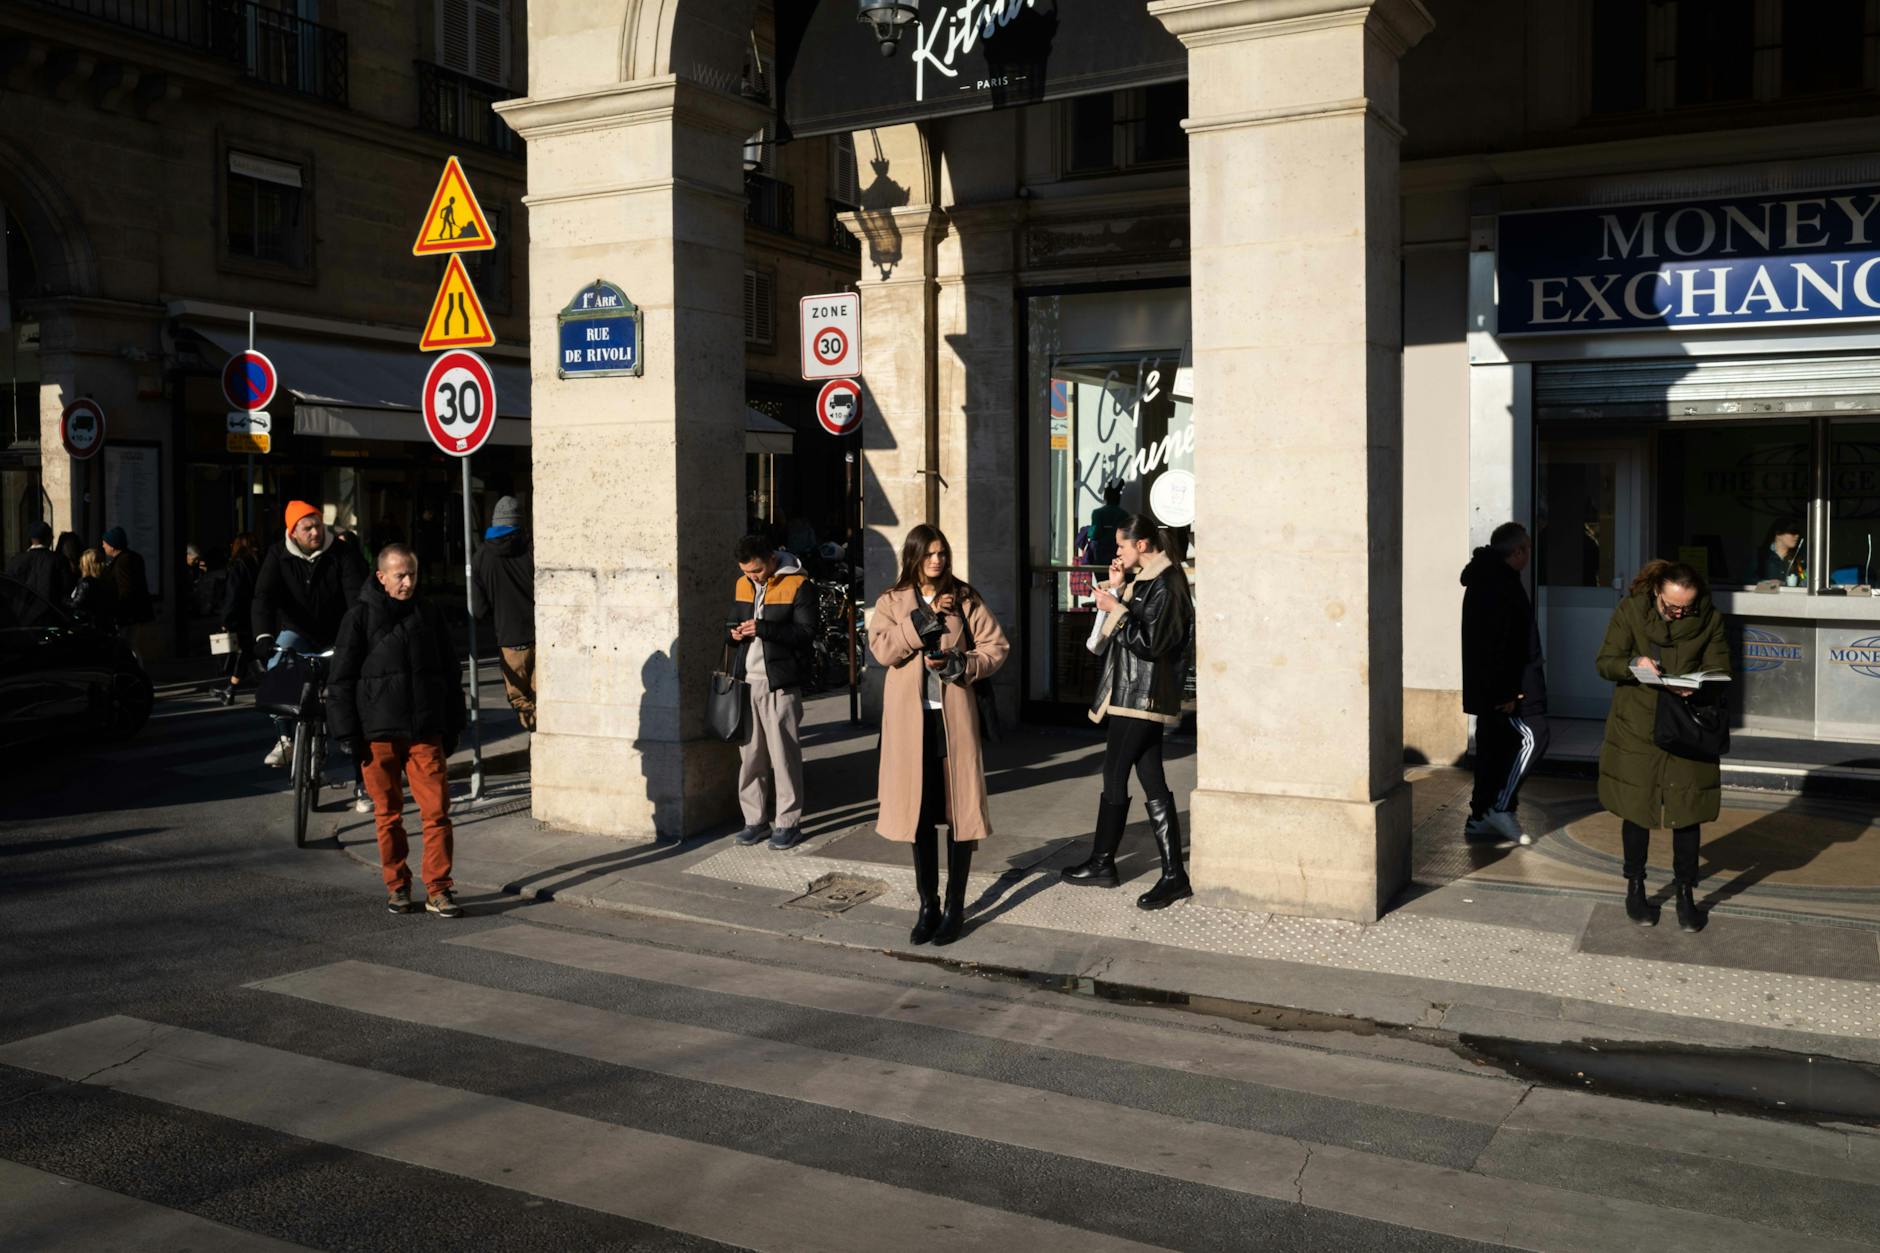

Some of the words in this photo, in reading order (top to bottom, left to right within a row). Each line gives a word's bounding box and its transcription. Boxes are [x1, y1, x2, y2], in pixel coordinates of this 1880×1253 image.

[911, 0, 1035, 102] Kitsu
[976, 76, 1009, 90] PARIS
[1597, 196, 1880, 261] MONEY
[812, 305, 847, 319] ZONE
[586, 327, 610, 341] RUE
[565, 349, 582, 363] DE
[586, 347, 631, 362] RIVOLI
[820, 337, 841, 355] 30
[438, 380, 481, 426] 30
[1097, 356, 1161, 444] Café
[1705, 471, 1754, 492] THE
[1761, 470, 1875, 491] CHGE
[1743, 644, 1802, 660] HANGE
